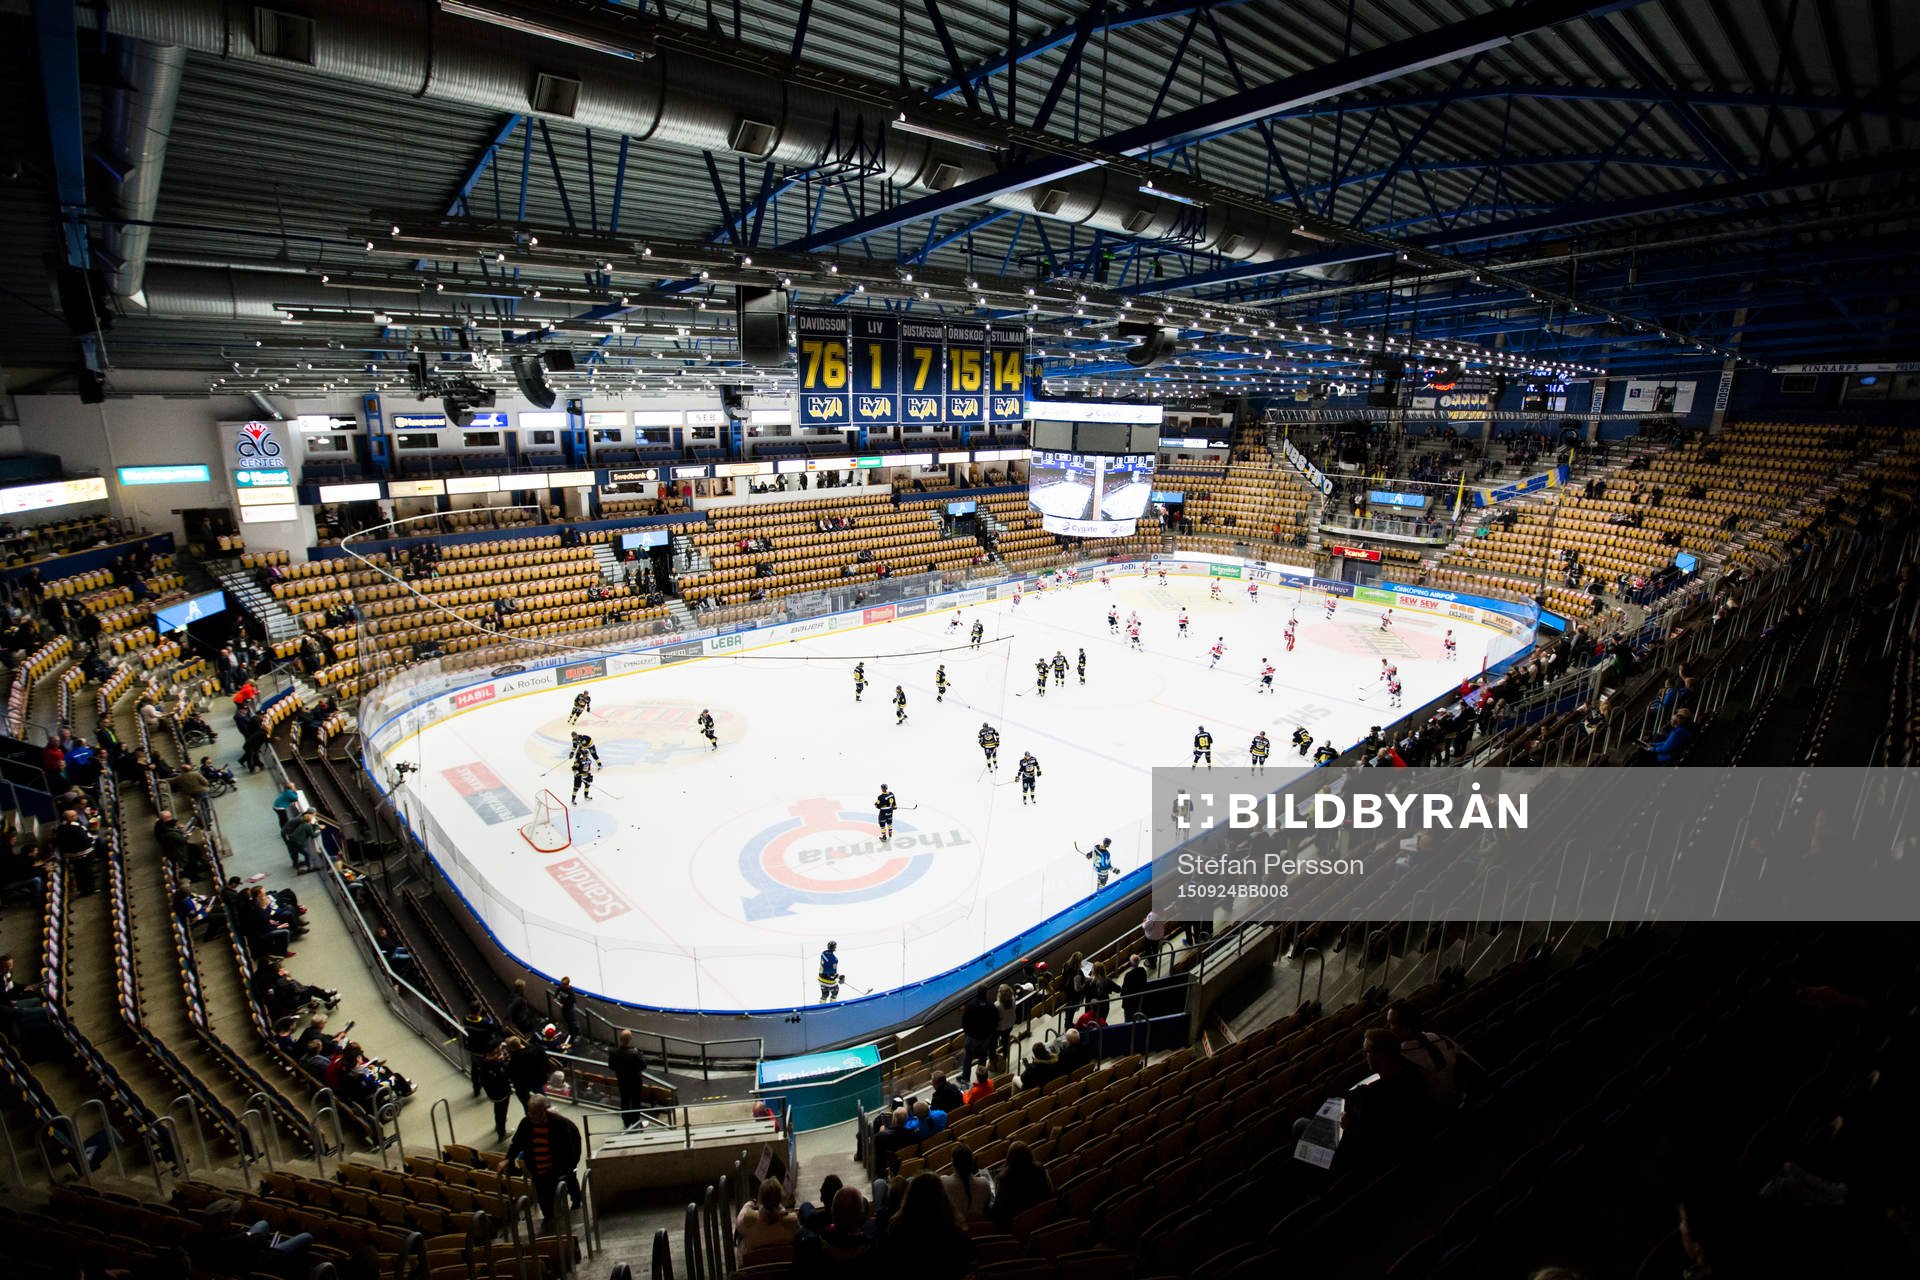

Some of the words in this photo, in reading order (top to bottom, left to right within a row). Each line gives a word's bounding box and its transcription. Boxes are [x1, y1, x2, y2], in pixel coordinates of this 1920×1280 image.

[800, 316, 847, 332] DAVIDSSON
[867, 321, 883, 334] LIV
[902, 327, 943, 338] GUSTAFSSON
[991, 331, 1024, 343] STILLMAN
[802, 341, 847, 389] 76
[869, 344, 882, 389] 1
[913, 347, 932, 391] 7
[950, 350, 982, 391] 15
[993, 351, 1022, 391] 14
[1801, 364, 1859, 374] KINNARPS
[240, 458, 285, 468] CENTER
[613, 471, 647, 480] Swedbank
[1071, 525, 1098, 534] Cygate
[1119, 563, 1137, 571] JoDi
[1256, 570, 1272, 580] IVT
[1392, 585, 1429, 597] JÖNKÖPING
[1399, 595, 1418, 606] SEW
[1420, 599, 1440, 609] SEW
[710, 635, 742, 650] LEBA
[458, 688, 493, 705] HABIL
[799, 829, 972, 865] Thermia
[557, 861, 625, 917] Scandic
